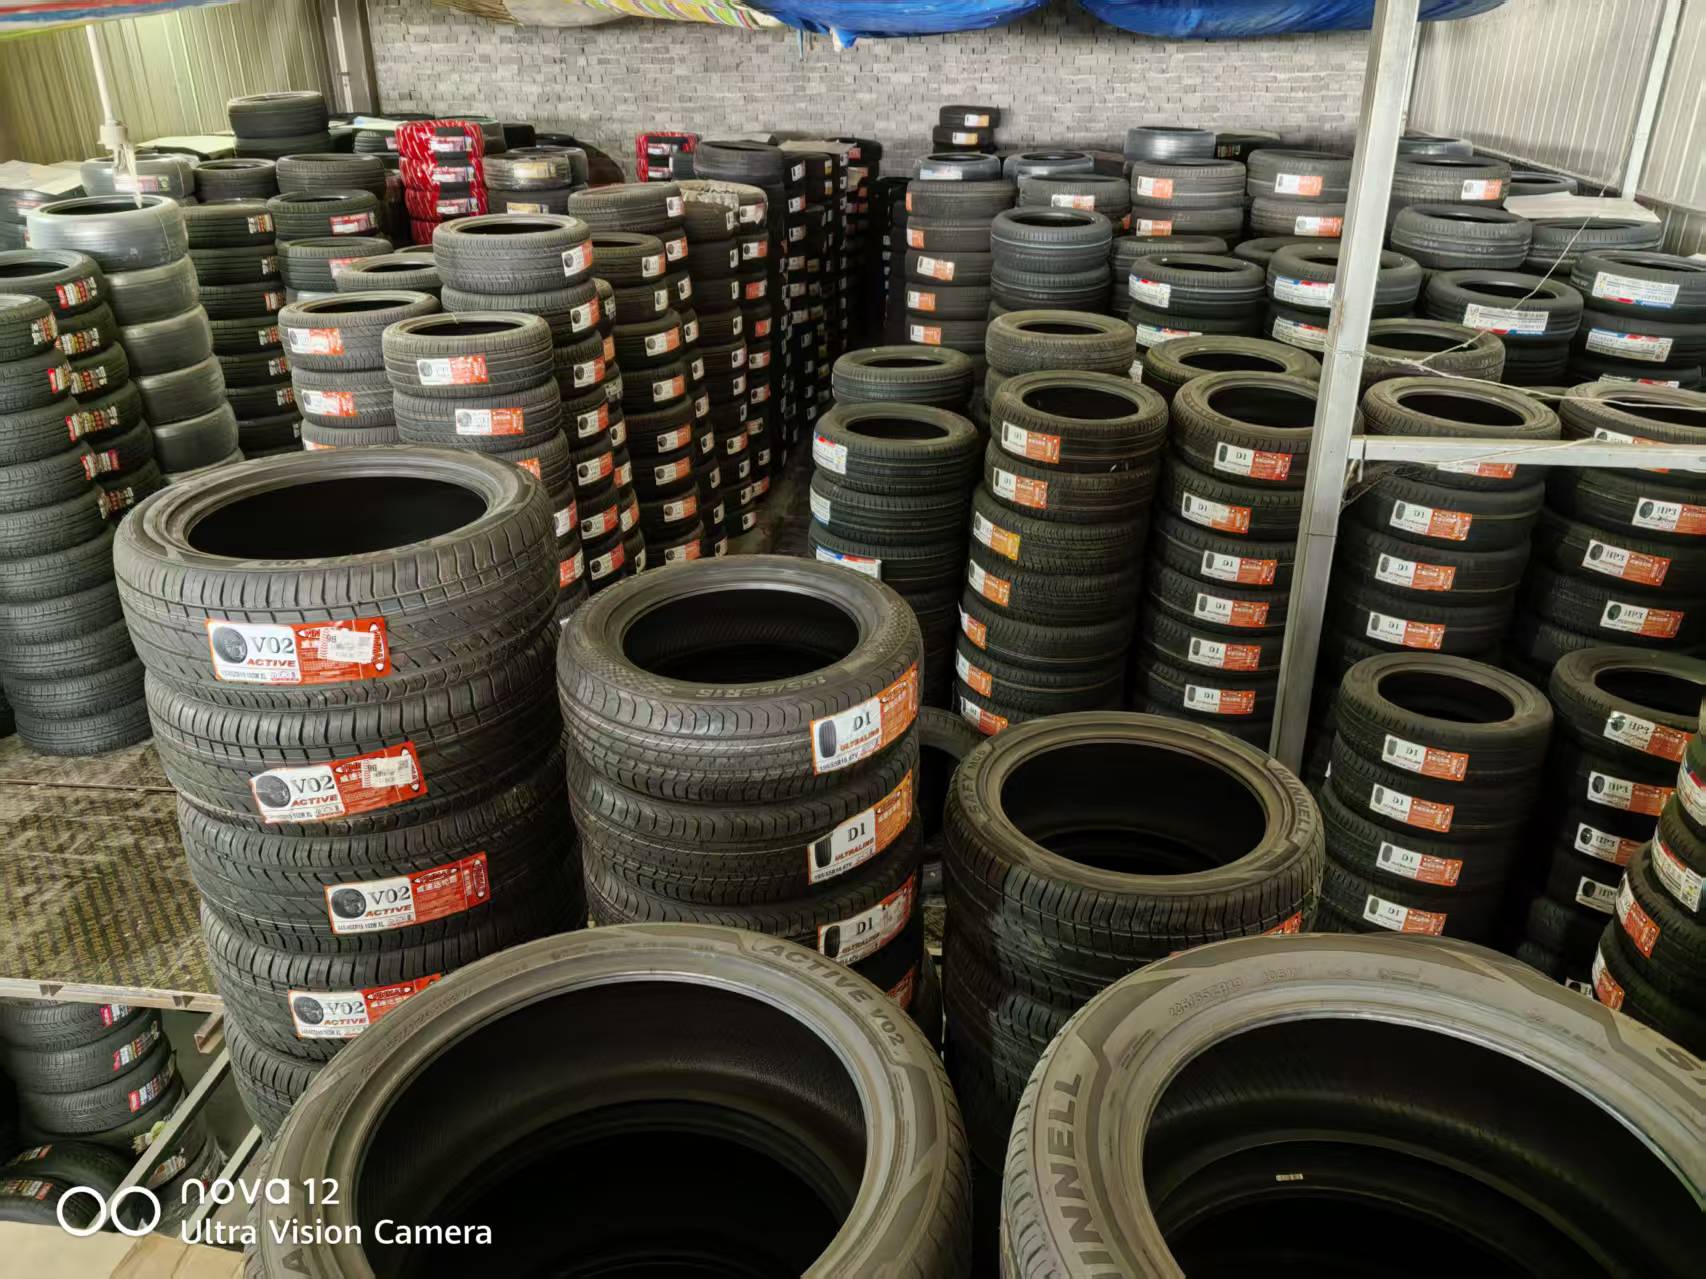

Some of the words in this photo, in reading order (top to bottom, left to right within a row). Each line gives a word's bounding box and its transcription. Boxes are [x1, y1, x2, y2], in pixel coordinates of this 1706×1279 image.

[250, 636, 295, 654] V02
[246, 658, 296, 667] ACTIVE
[853, 711, 872, 732] D1
[290, 775, 335, 794] V02
[290, 794, 338, 807] ACTIVE
[1271, 768, 1311, 834] MINNELL
[847, 823, 866, 842] D1
[368, 885, 411, 905] V02
[365, 905, 412, 917] ACTIVE
[856, 917, 873, 936] D1
[765, 944, 872, 1003] ACTIVE
[870, 1007, 905, 1047] V02
[323, 1000, 365, 1015] V02
[323, 1018, 367, 1026] ACTIVE
[1047, 1073, 1122, 1279] INNELL
